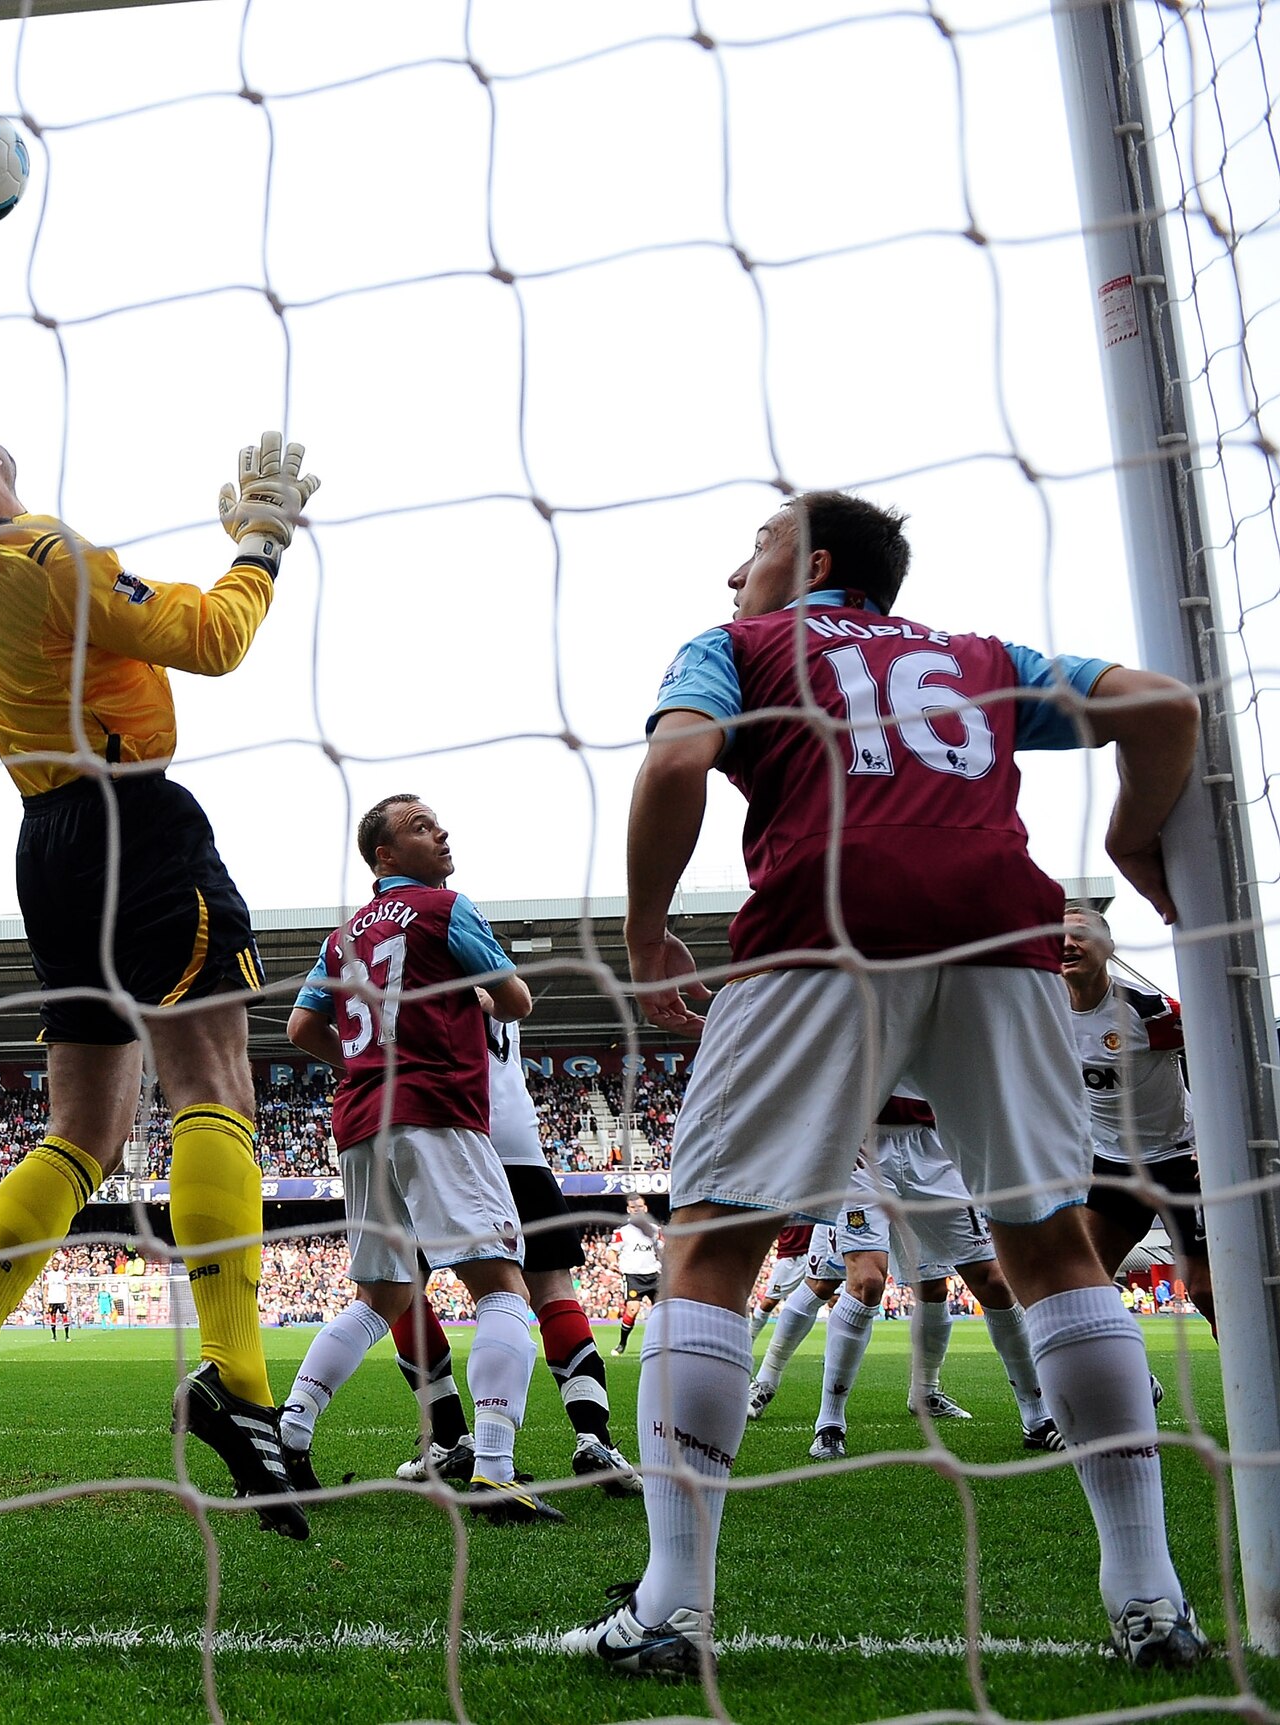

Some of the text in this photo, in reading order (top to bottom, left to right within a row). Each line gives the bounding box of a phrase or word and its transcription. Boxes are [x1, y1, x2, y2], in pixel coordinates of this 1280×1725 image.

[804, 615, 950, 646] NOBLE
[822, 644, 995, 780] 16
[341, 933, 407, 1059] 37
[620, 1173, 671, 1194] SBO
